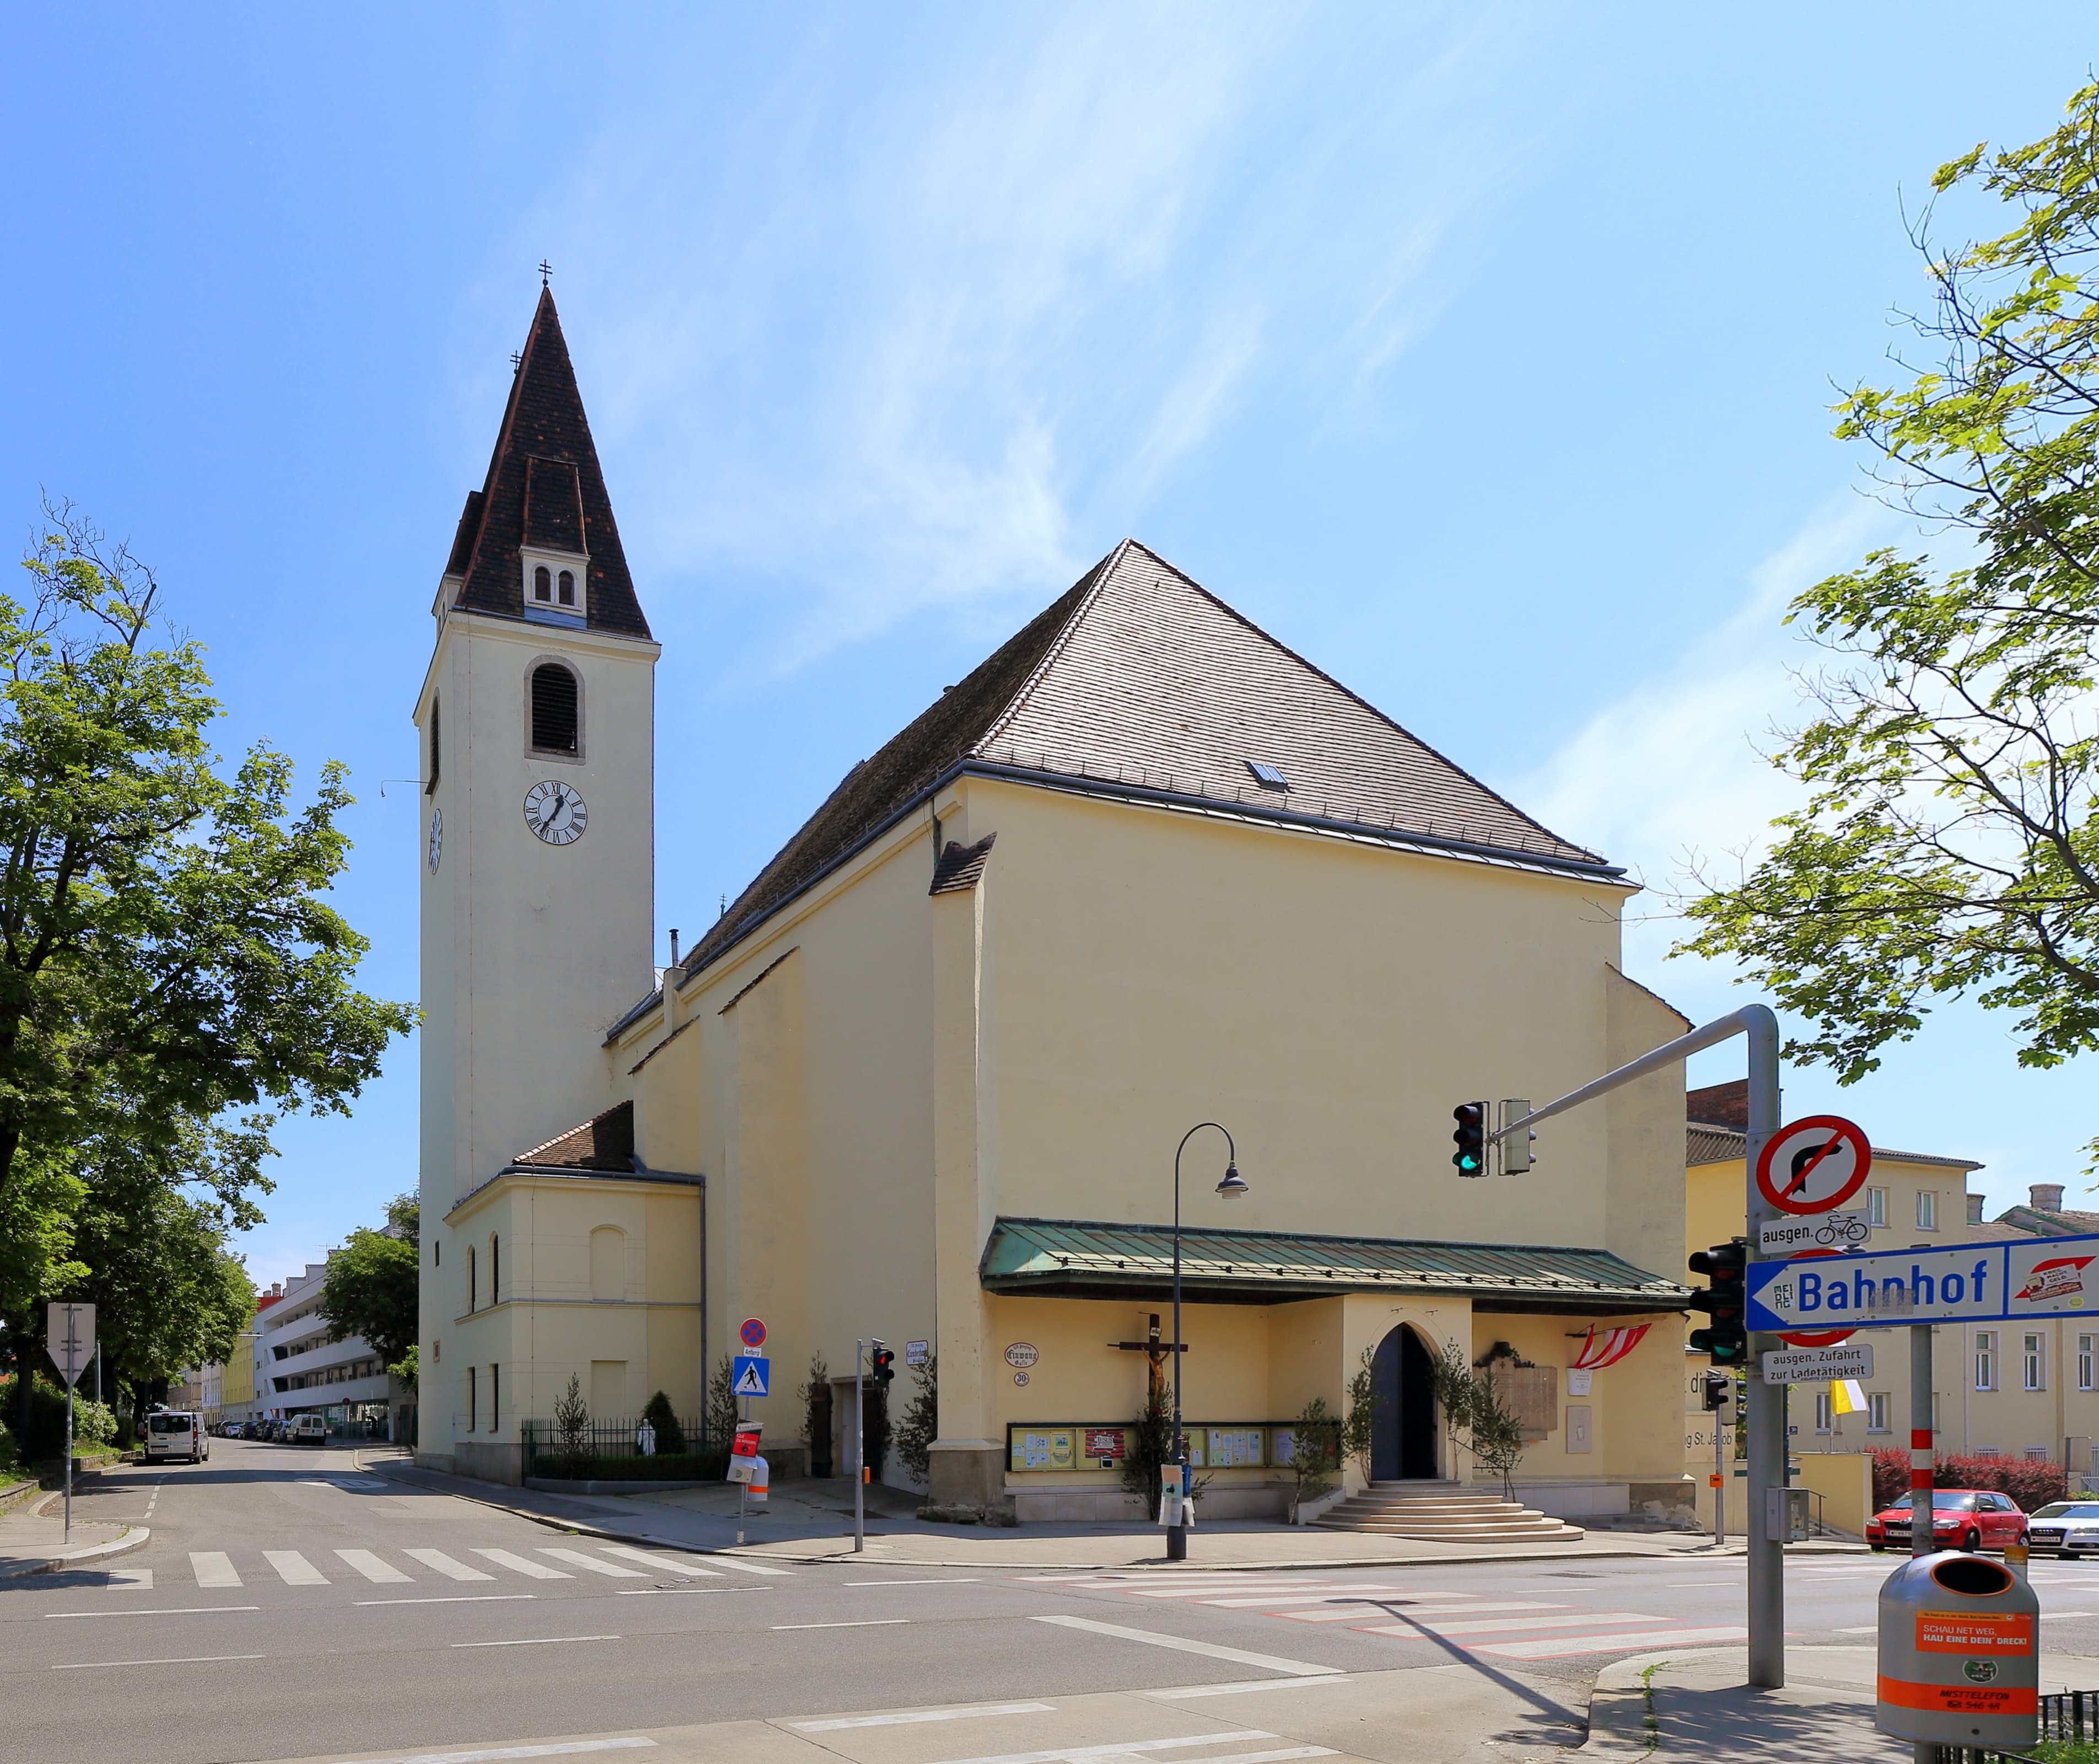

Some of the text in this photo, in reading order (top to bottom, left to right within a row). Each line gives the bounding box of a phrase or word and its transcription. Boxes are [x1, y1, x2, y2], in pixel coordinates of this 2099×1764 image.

[551, 782, 561, 794] XII
[1763, 1227, 1813, 1244] ausgen.
[1799, 1260, 1988, 1312] Bahnhof
[1007, 1349, 1037, 1362] Einwang
[1773, 1349, 1861, 1365] ausgen. Zufahrt
[1017, 1374, 1026, 1382] 30
[1770, 1371, 1788, 1380] zur
[1791, 1364, 1866, 1379] Ladetätigkeit
[1685, 1432, 1732, 1448] g St. Jaob
[1923, 1625, 1954, 1634] SCHAU
[1976, 1627, 1997, 1636] WEG,
[1923, 1634, 1943, 1642] HAU
[1946, 1635, 1968, 1644] EINE
[1996, 1637, 2027, 1645] DRECK!
[1940, 1690, 2010, 1700] MISTTELEFON
[1965, 1701, 1984, 1709] 546
